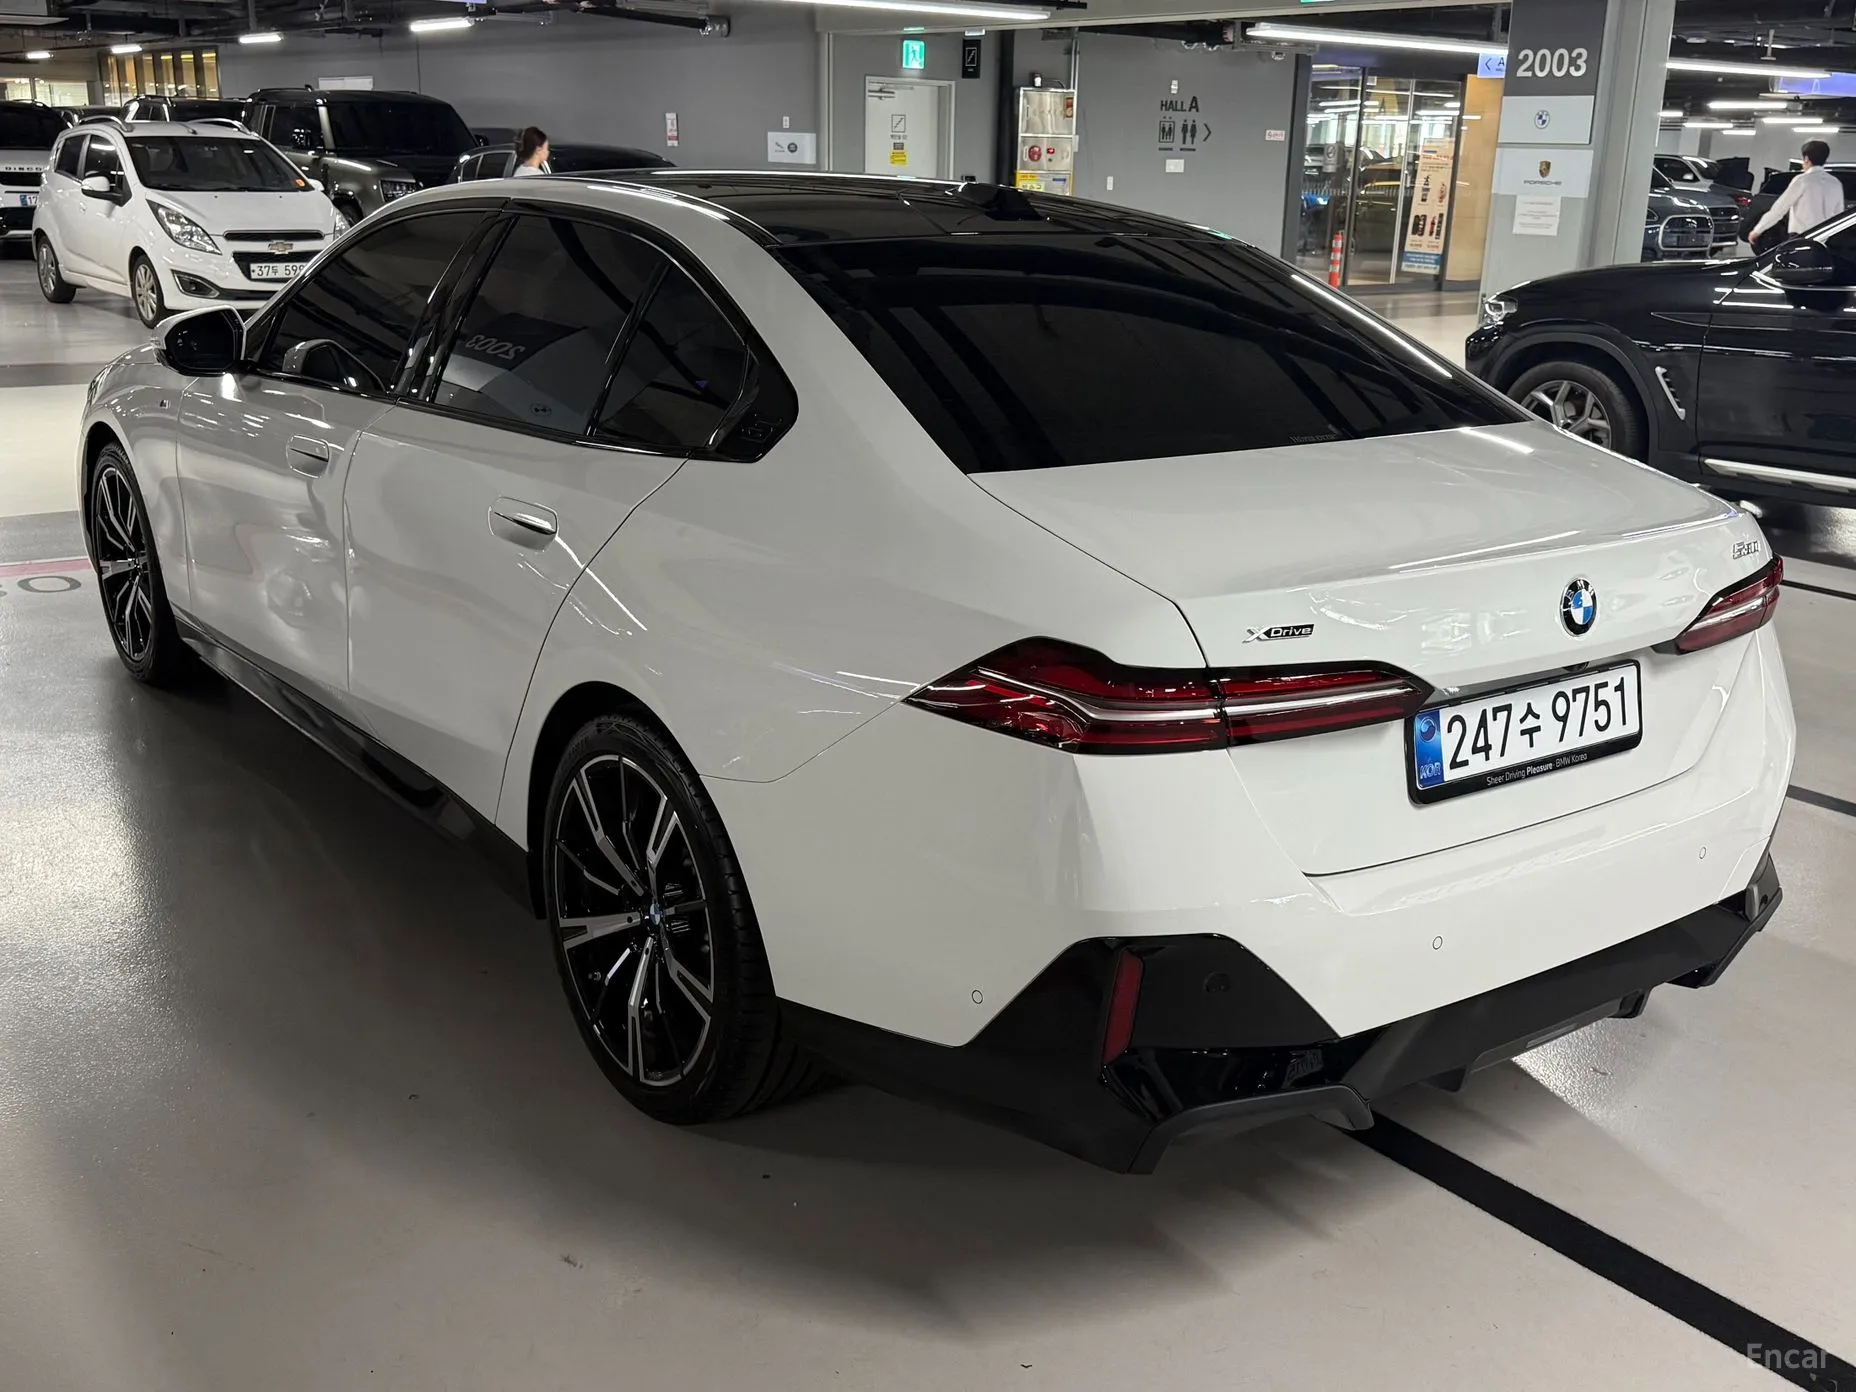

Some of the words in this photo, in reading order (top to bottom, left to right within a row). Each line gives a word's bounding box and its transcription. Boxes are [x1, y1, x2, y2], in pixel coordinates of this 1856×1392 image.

[1516, 47, 1588, 78] 2003
[1160, 100, 1187, 112] HALL
[1188, 95, 1199, 113] A
[1447, 702, 1541, 770] 247수
[1551, 676, 1628, 742] 9751
[1419, 762, 1441, 779] KOR
[1486, 775, 1504, 786] Sheer
[1505, 769, 1526, 782] Driving
[1526, 763, 1553, 776] Pleasure
[1555, 756, 1571, 768] BMW
[1571, 753, 1588, 764] Korea
